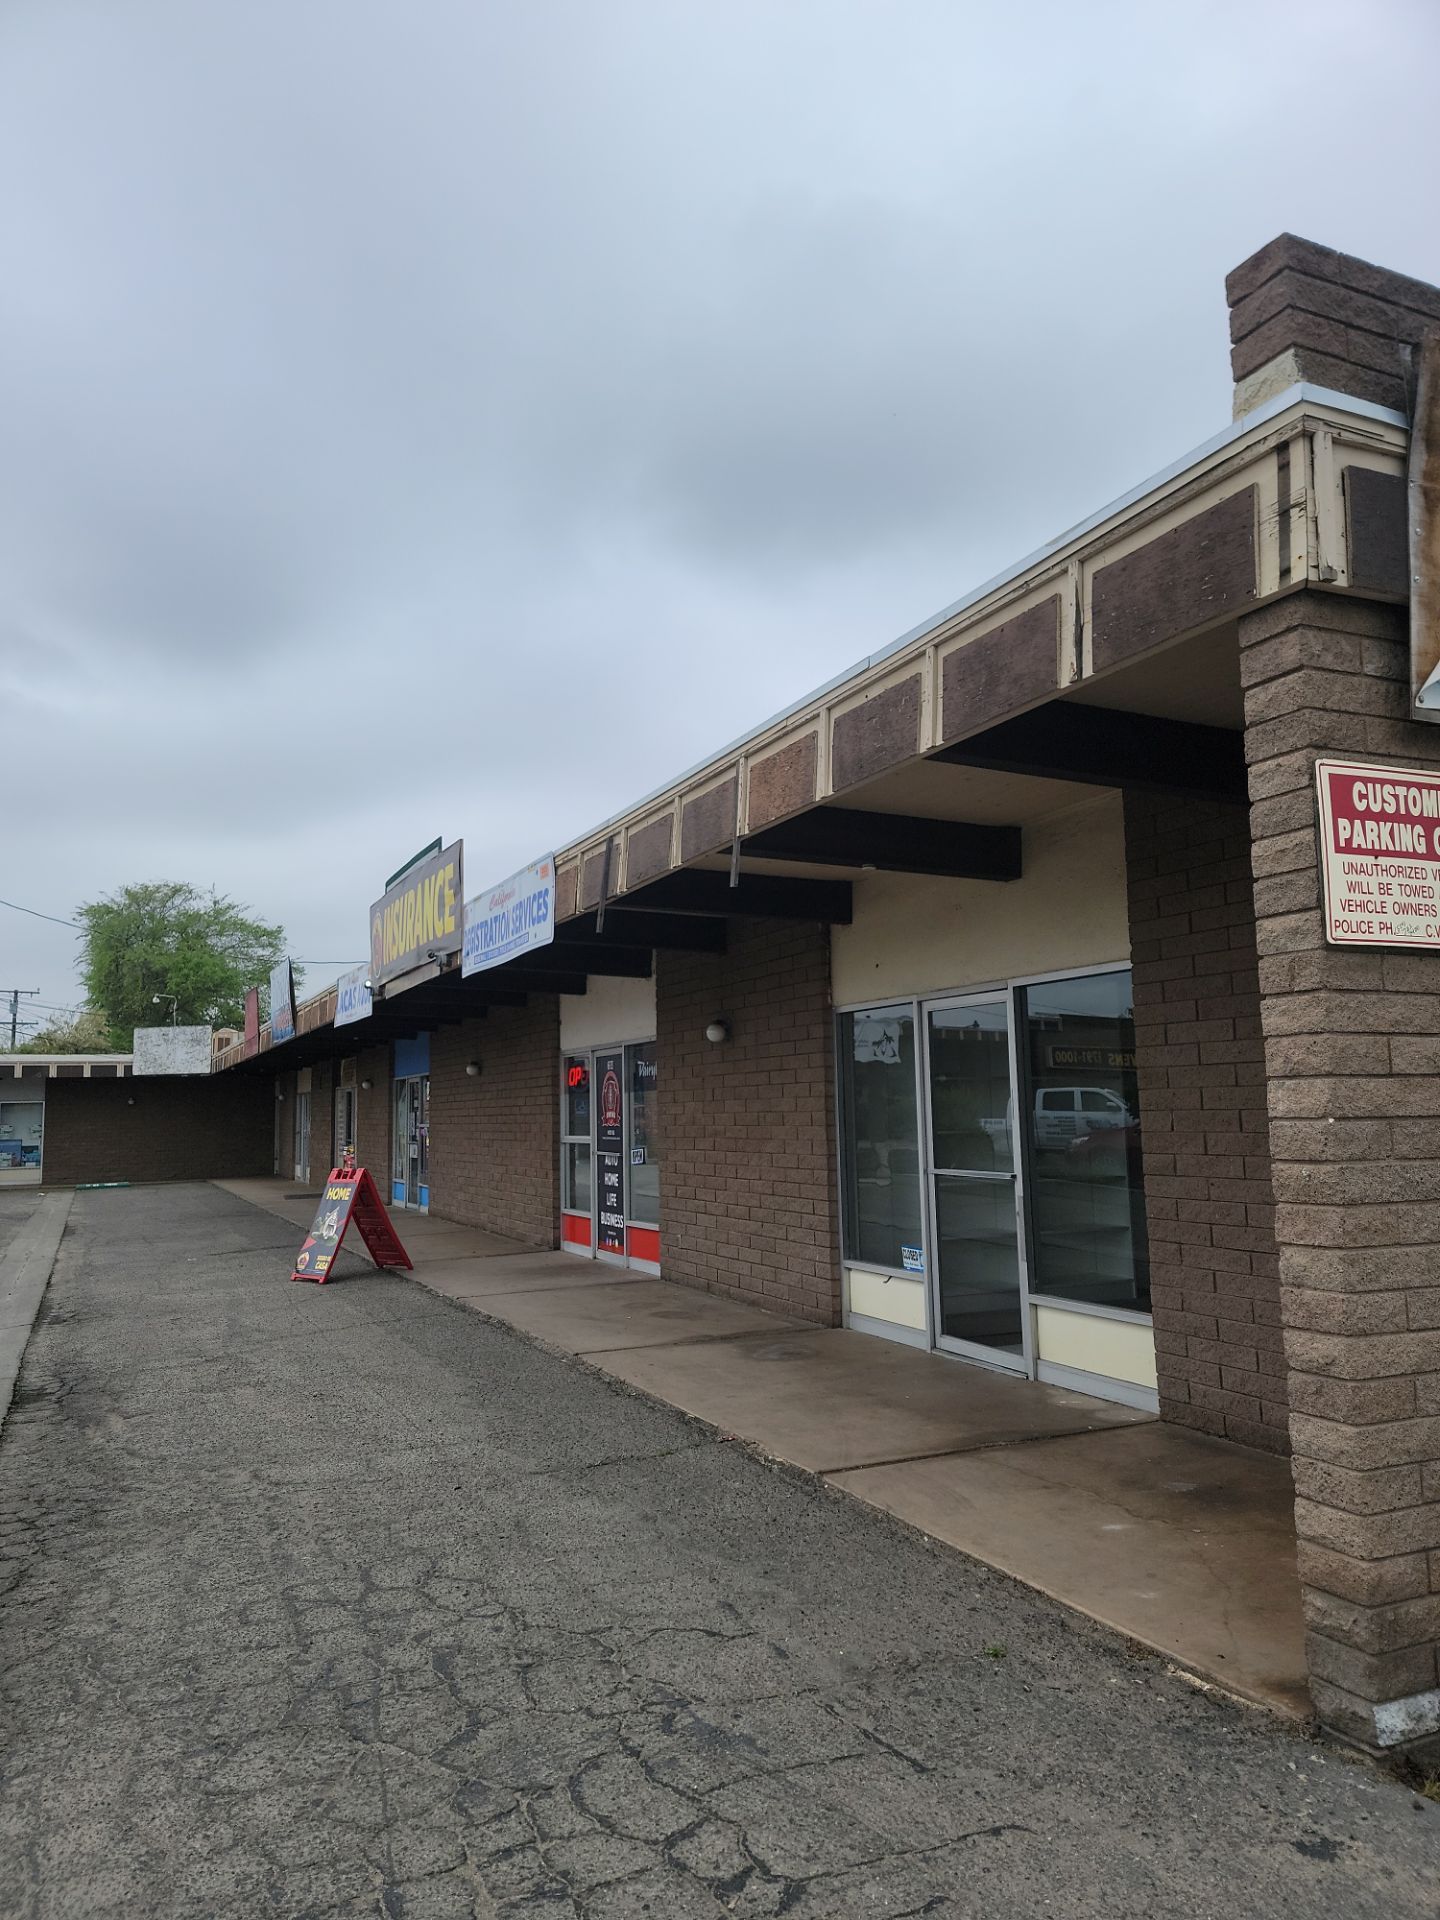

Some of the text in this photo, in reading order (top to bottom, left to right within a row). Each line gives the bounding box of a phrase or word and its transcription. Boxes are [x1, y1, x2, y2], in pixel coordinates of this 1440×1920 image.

[1352, 781, 1440, 818] CUSTOM
[1337, 817, 1427, 854] PARKING
[1343, 861, 1428, 880] UNAUTHORIZED
[1346, 880, 1434, 899] WILL BE TOWED
[383, 862, 456, 966] INSURANCE
[511, 887, 549, 937] SERVICES
[1339, 898, 1438, 917] VEHICLE OWNERS
[1334, 919, 1374, 934] POLICE
[604, 1172, 619, 1186] HOME
[326, 1187, 352, 1200] HOME
[606, 1192, 617, 1206] LIFE
[601, 1211, 624, 1228] BUSINESS
